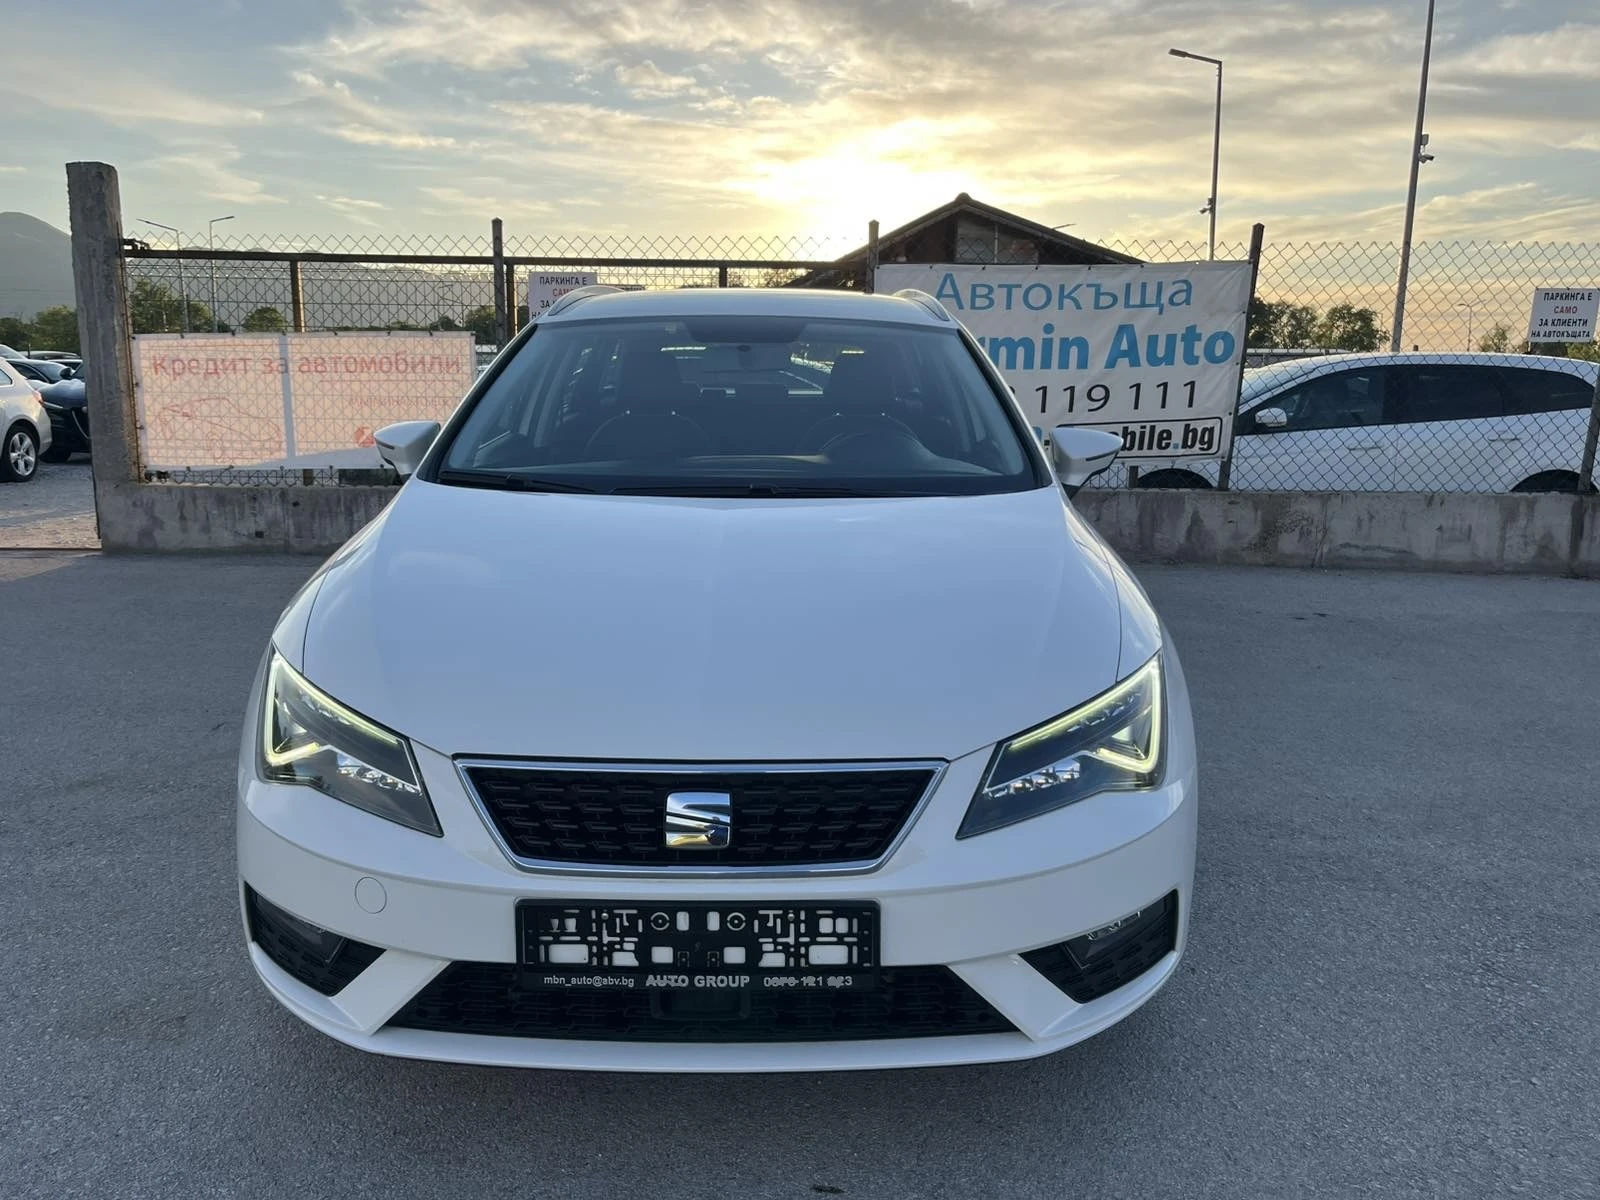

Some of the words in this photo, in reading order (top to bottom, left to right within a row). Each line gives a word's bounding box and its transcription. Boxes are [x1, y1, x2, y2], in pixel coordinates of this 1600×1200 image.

[539, 276, 580, 286] ПАРКИНГА
[582, 276, 587, 285] Е
[552, 288, 574, 297] САМ
[935, 272, 1193, 315] Автокъща
[1543, 292, 1585, 300] ПАРКИНГА
[1588, 292, 1592, 300] Е
[540, 299, 551, 308] ЗА
[1554, 306, 1577, 314] САМО
[1539, 318, 1548, 327] ЗА
[1550, 318, 1588, 327] КЛИЕНТИ
[1531, 330, 1540, 338] НА
[1542, 330, 1590, 339] АВТОКЪЩАТА
[977, 323, 1090, 370] min
[1104, 323, 1235, 369] Auto
[152, 353, 252, 381] Кредит
[261, 357, 289, 375] за
[298, 351, 461, 374] автомобили
[1035, 383, 1110, 413] 119
[1129, 380, 1196, 410] 111
[1109, 423, 1215, 452] bile.bg
[543, 975, 635, 988] mbn_auto@abv.bg
[645, 974, 689, 987] AUTO
[693, 975, 750, 988] GROUP
